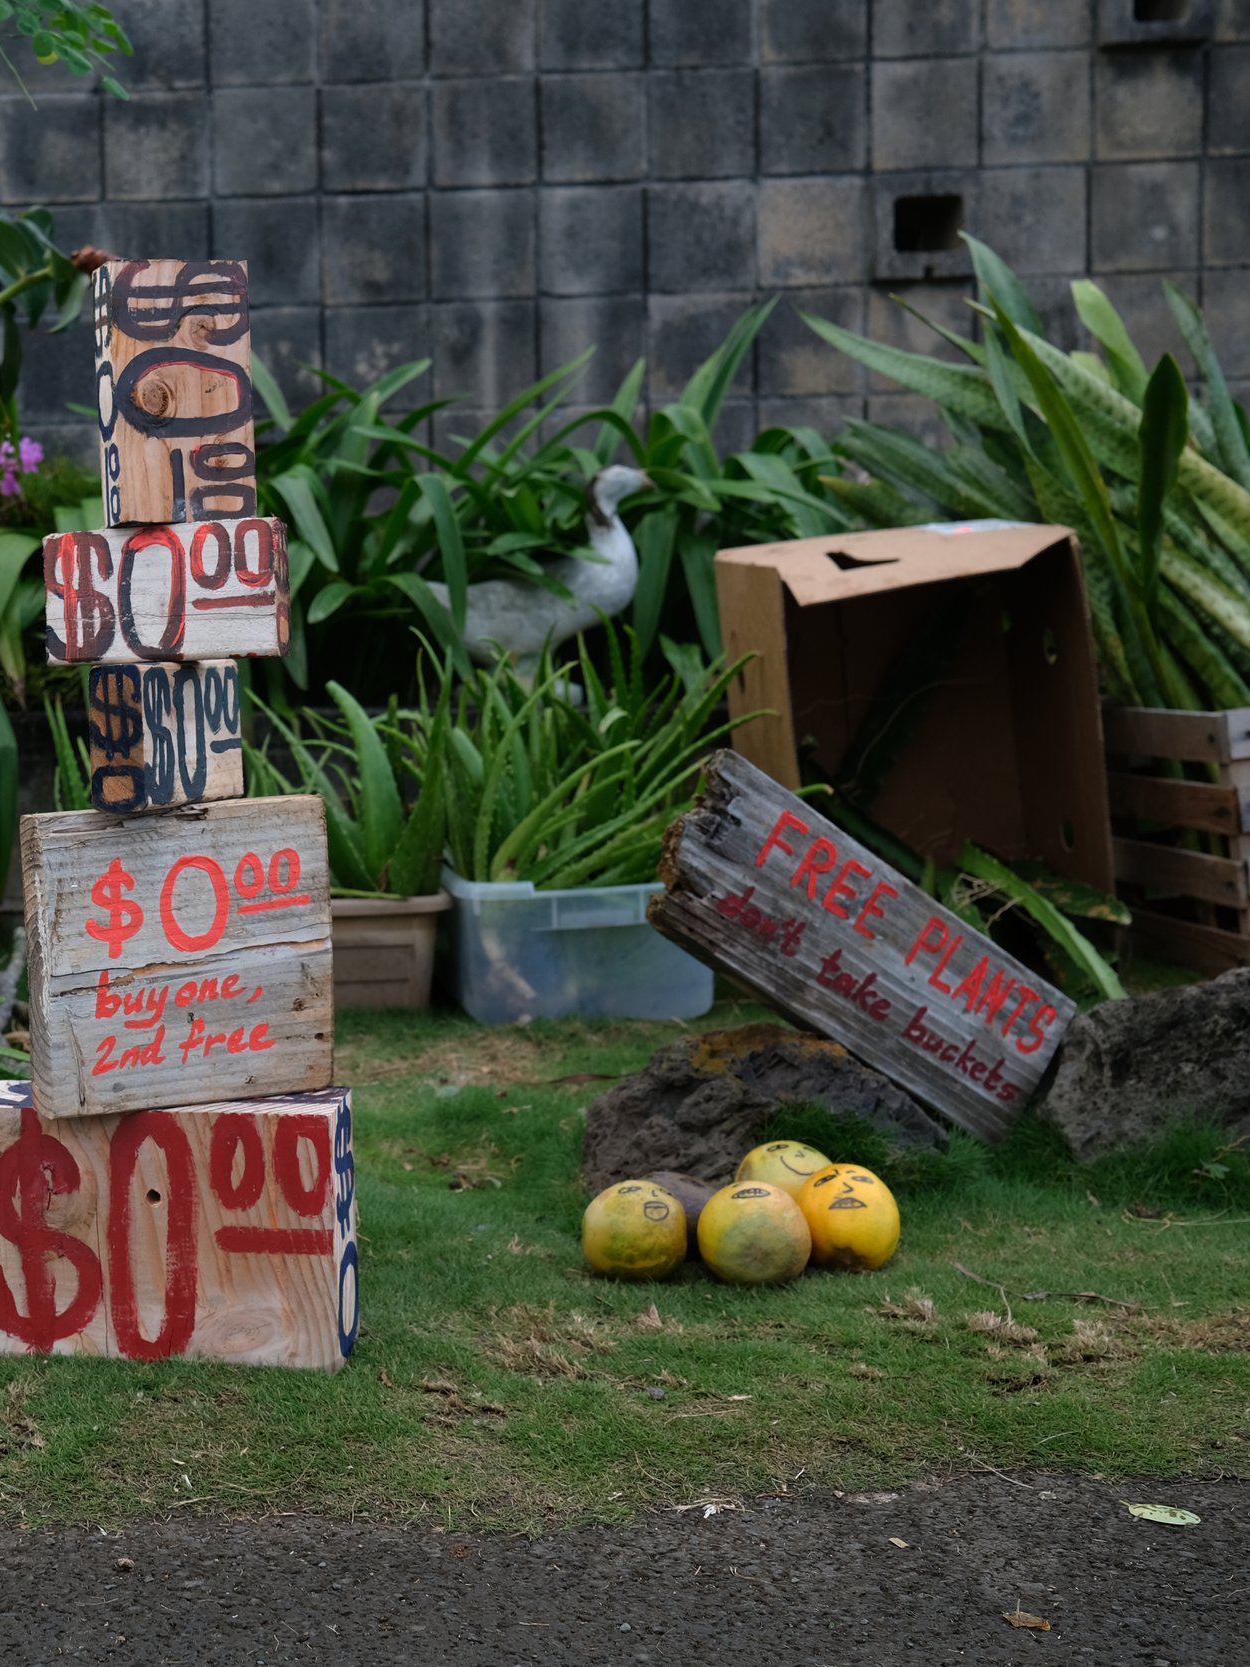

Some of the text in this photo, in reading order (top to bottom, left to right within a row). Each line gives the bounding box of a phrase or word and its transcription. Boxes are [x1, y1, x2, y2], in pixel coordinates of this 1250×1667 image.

[755, 810, 1057, 1054] FREE PLANTS
[92, 1017, 276, 1076] 2nd free
[95, 970, 263, 1029] buy one,
[816, 949, 891, 1022] take
[902, 1007, 1024, 1101] buckets
